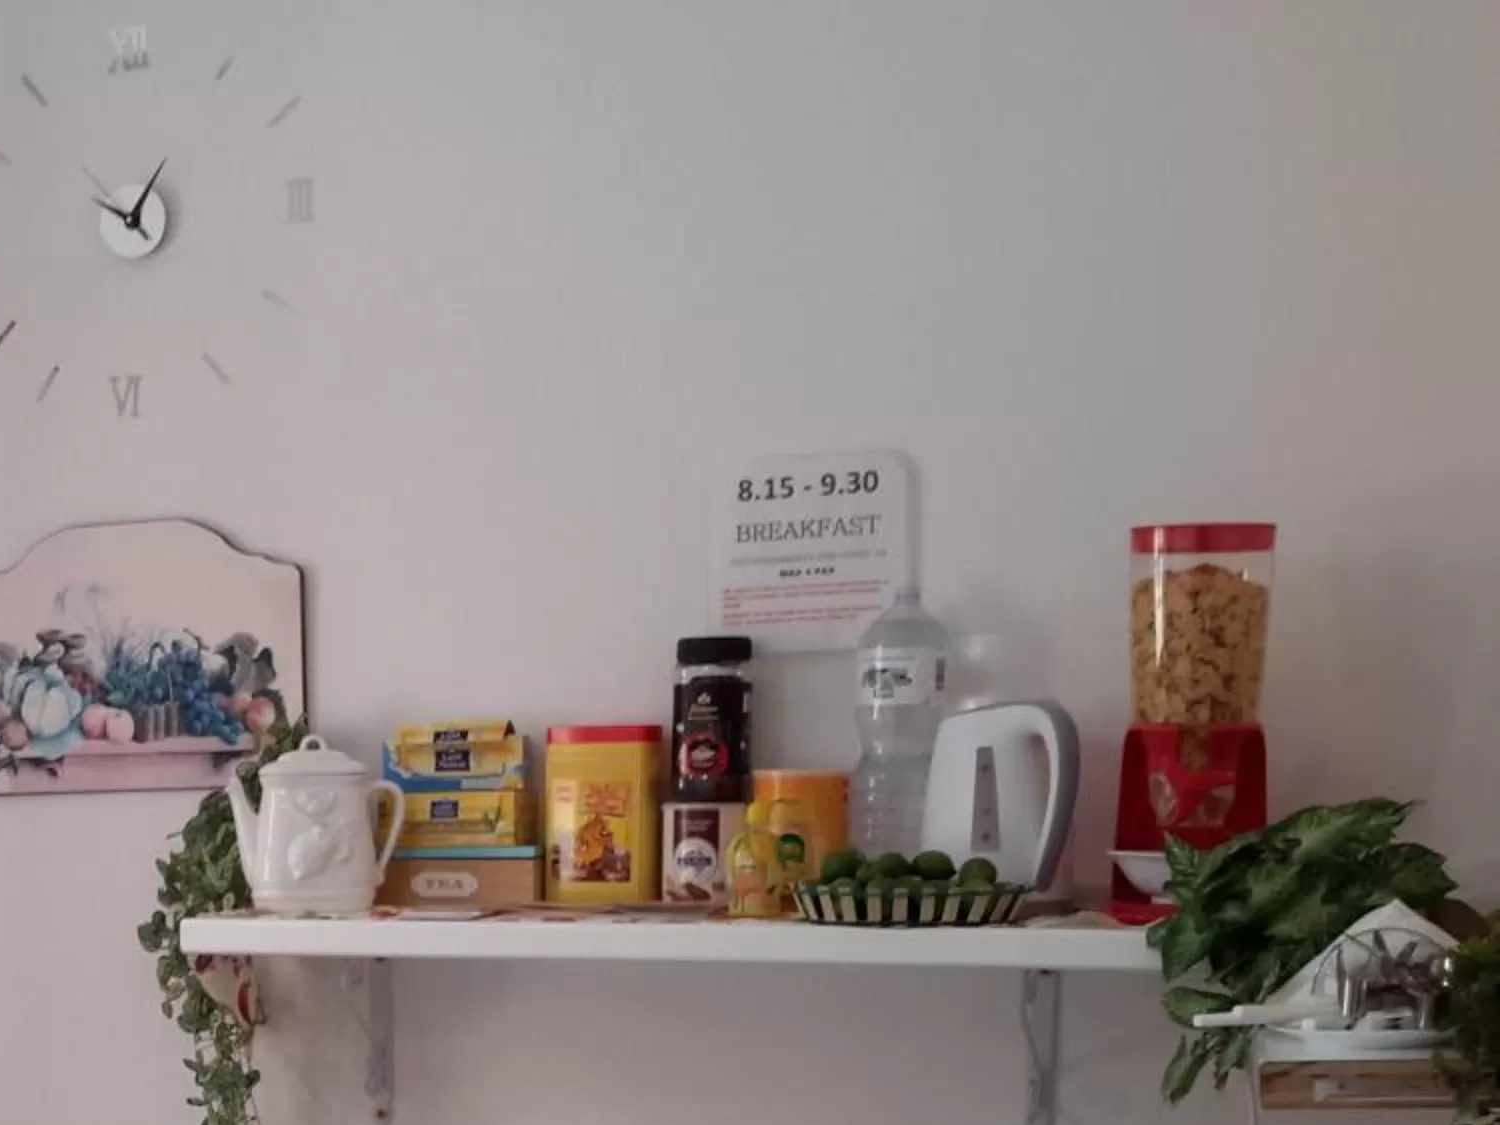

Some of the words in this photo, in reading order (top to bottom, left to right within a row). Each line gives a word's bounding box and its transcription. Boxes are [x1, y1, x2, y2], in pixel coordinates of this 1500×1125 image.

[108, 374, 143, 418] VI
[737, 477, 794, 502] 8.15
[820, 470, 879, 497] 9.30
[735, 513, 882, 544] BREAKFAST
